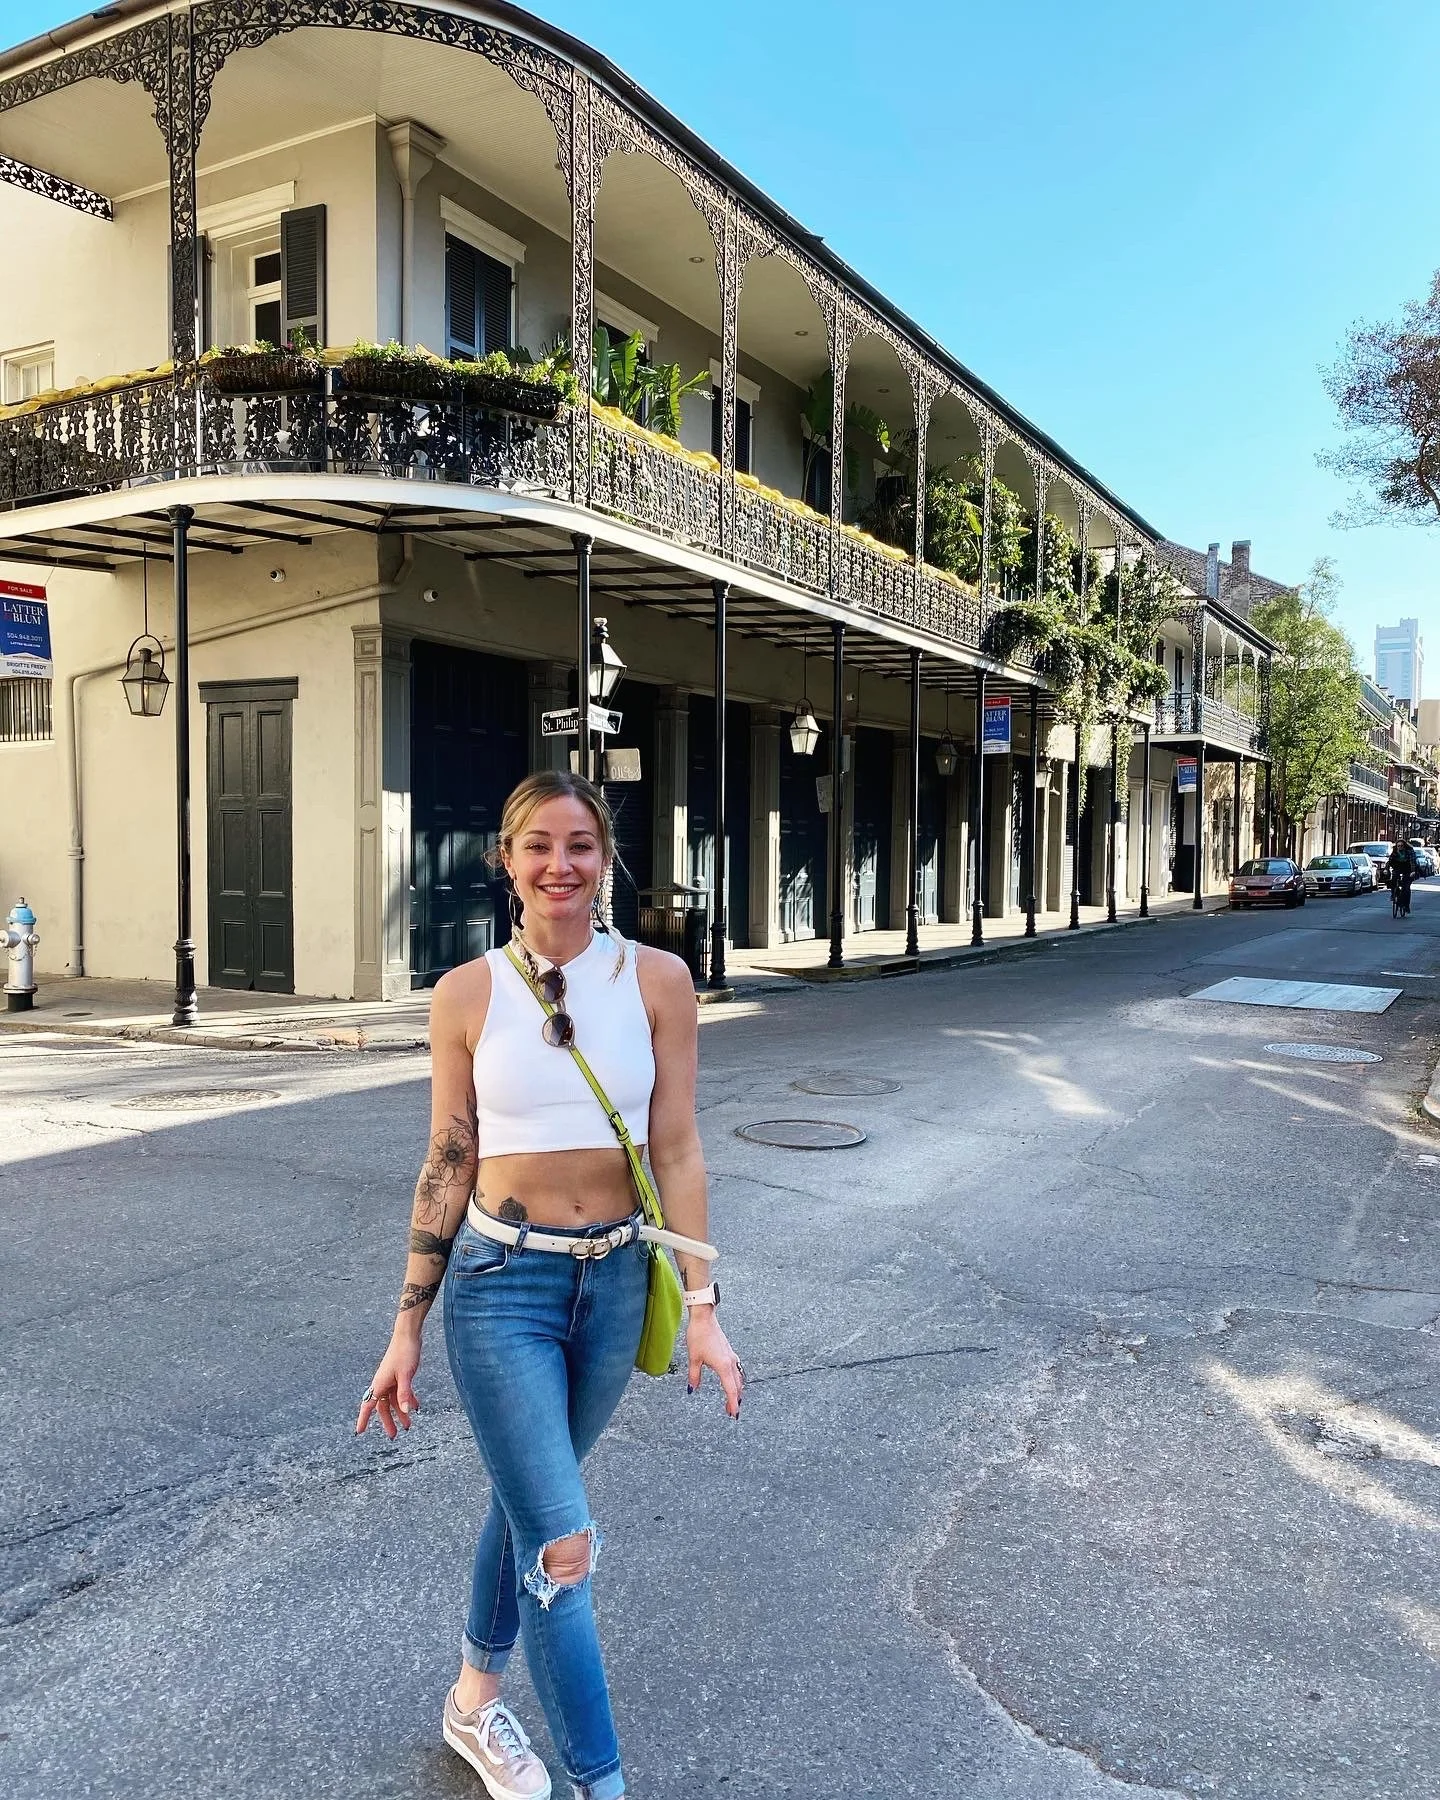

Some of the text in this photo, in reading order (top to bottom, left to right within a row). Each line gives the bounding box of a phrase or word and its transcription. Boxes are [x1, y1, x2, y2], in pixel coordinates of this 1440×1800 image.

[3, 601, 44, 617] LATTER
[13, 612, 41, 625] BLUM
[984, 710, 1007, 718] ATTER
[543, 720, 554, 731] St.
[556, 716, 579, 730] Philip
